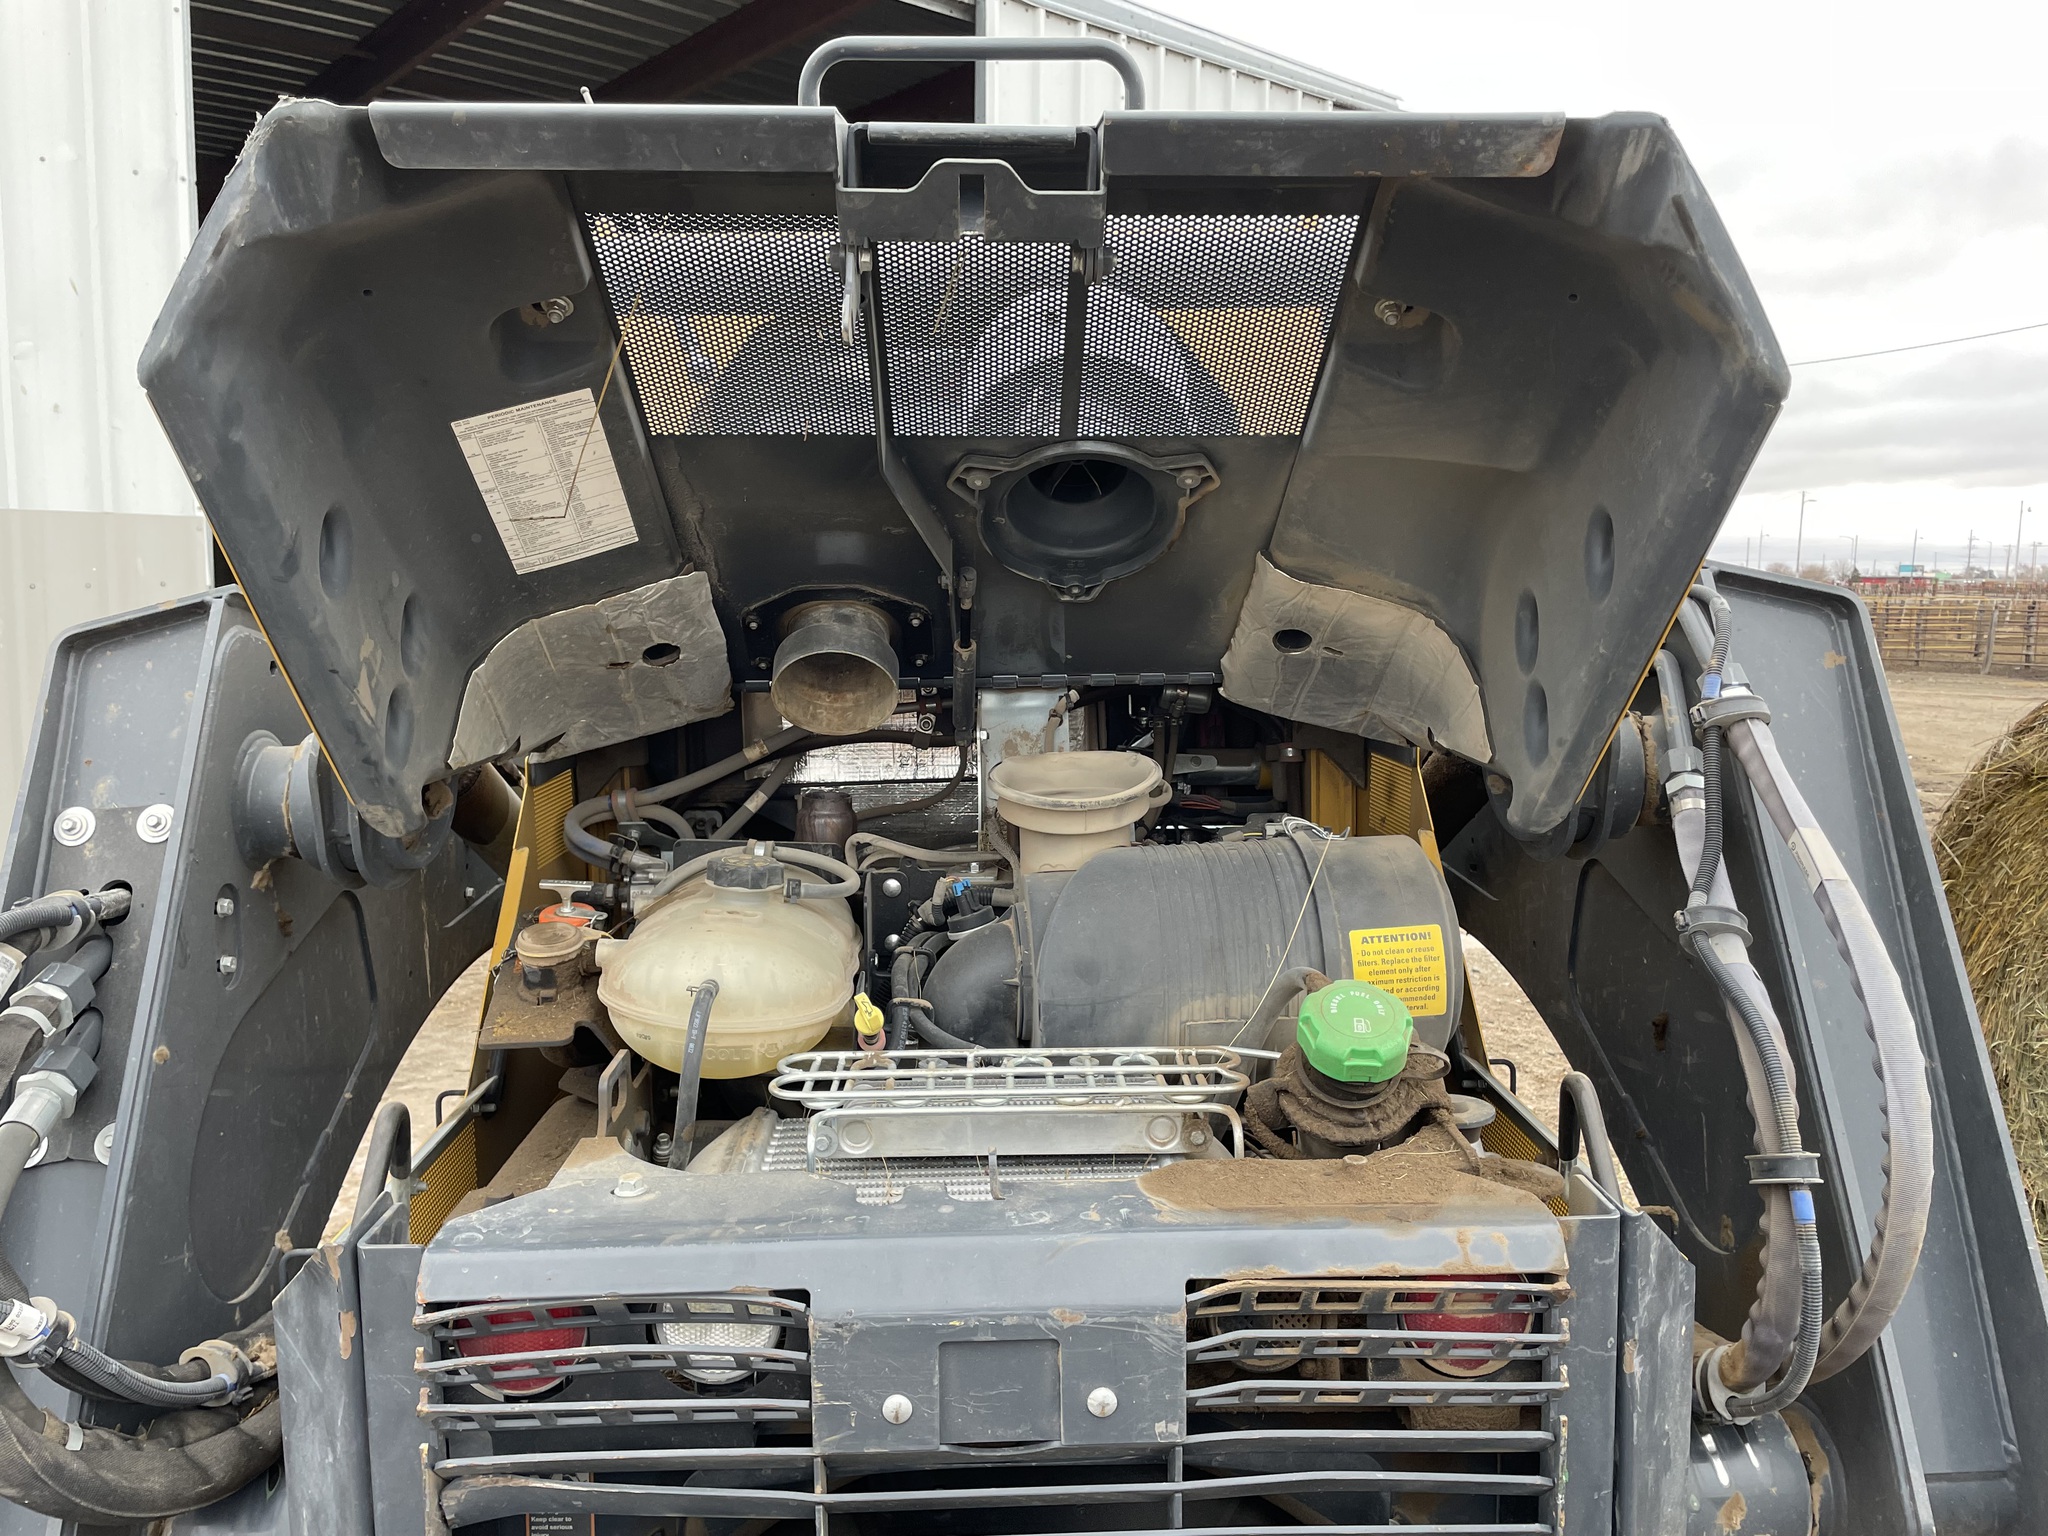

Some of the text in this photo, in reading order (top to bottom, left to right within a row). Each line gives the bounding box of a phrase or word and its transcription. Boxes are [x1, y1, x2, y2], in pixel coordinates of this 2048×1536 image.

[487, 398, 558, 420] PERIODIC MAINTENANCE
[1361, 931, 1432, 945] ATTENTION!
[1361, 949, 1371, 957] Do
[1372, 948, 1384, 956] not
[1385, 947, 1405, 955] clean
[1357, 954, 1441, 967] filters. Replace the filter
[1368, 965, 1431, 977] element only after
[1367, 977, 1395, 986] aximum
[1396, 975, 1432, 984] restriction
[1405, 984, 1440, 993] according
[1350, 990, 1370, 1000] FUEL
